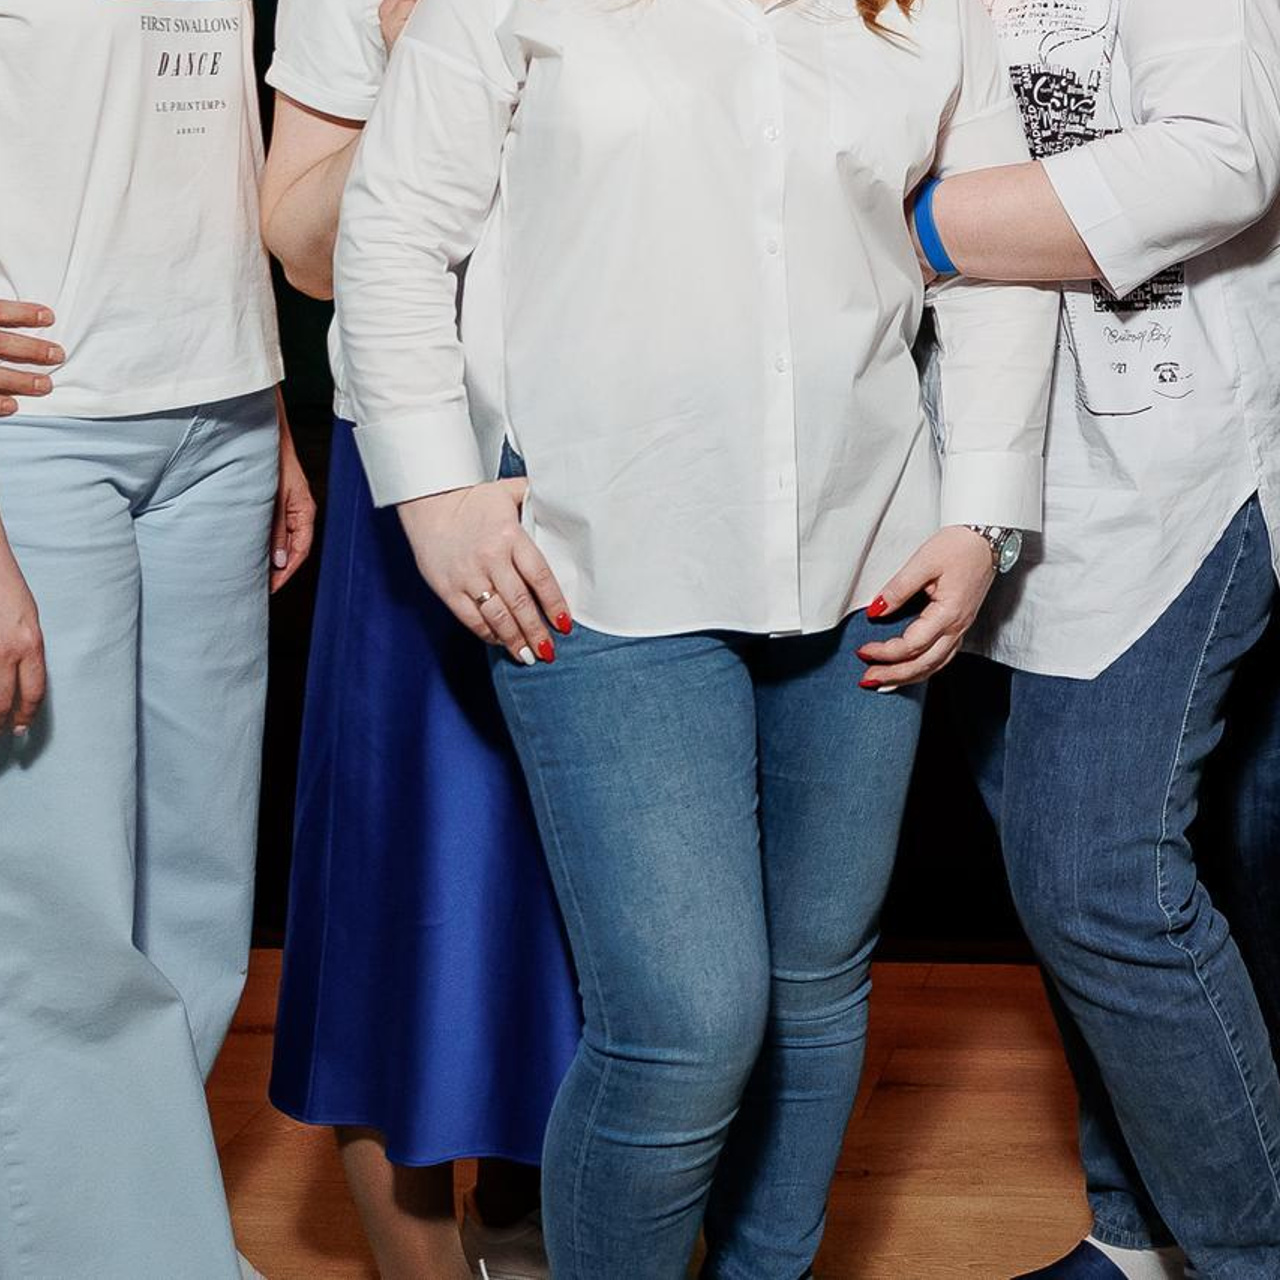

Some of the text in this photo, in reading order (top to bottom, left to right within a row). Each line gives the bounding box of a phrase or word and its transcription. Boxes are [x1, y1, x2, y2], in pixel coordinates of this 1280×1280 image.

[141, 15, 239, 33] FIRST SWALLOWS
[157, 52, 222, 76] DANCE
[170, 100, 227, 112] PRINTEMPS
[1027, 105, 1044, 154] MADRID
